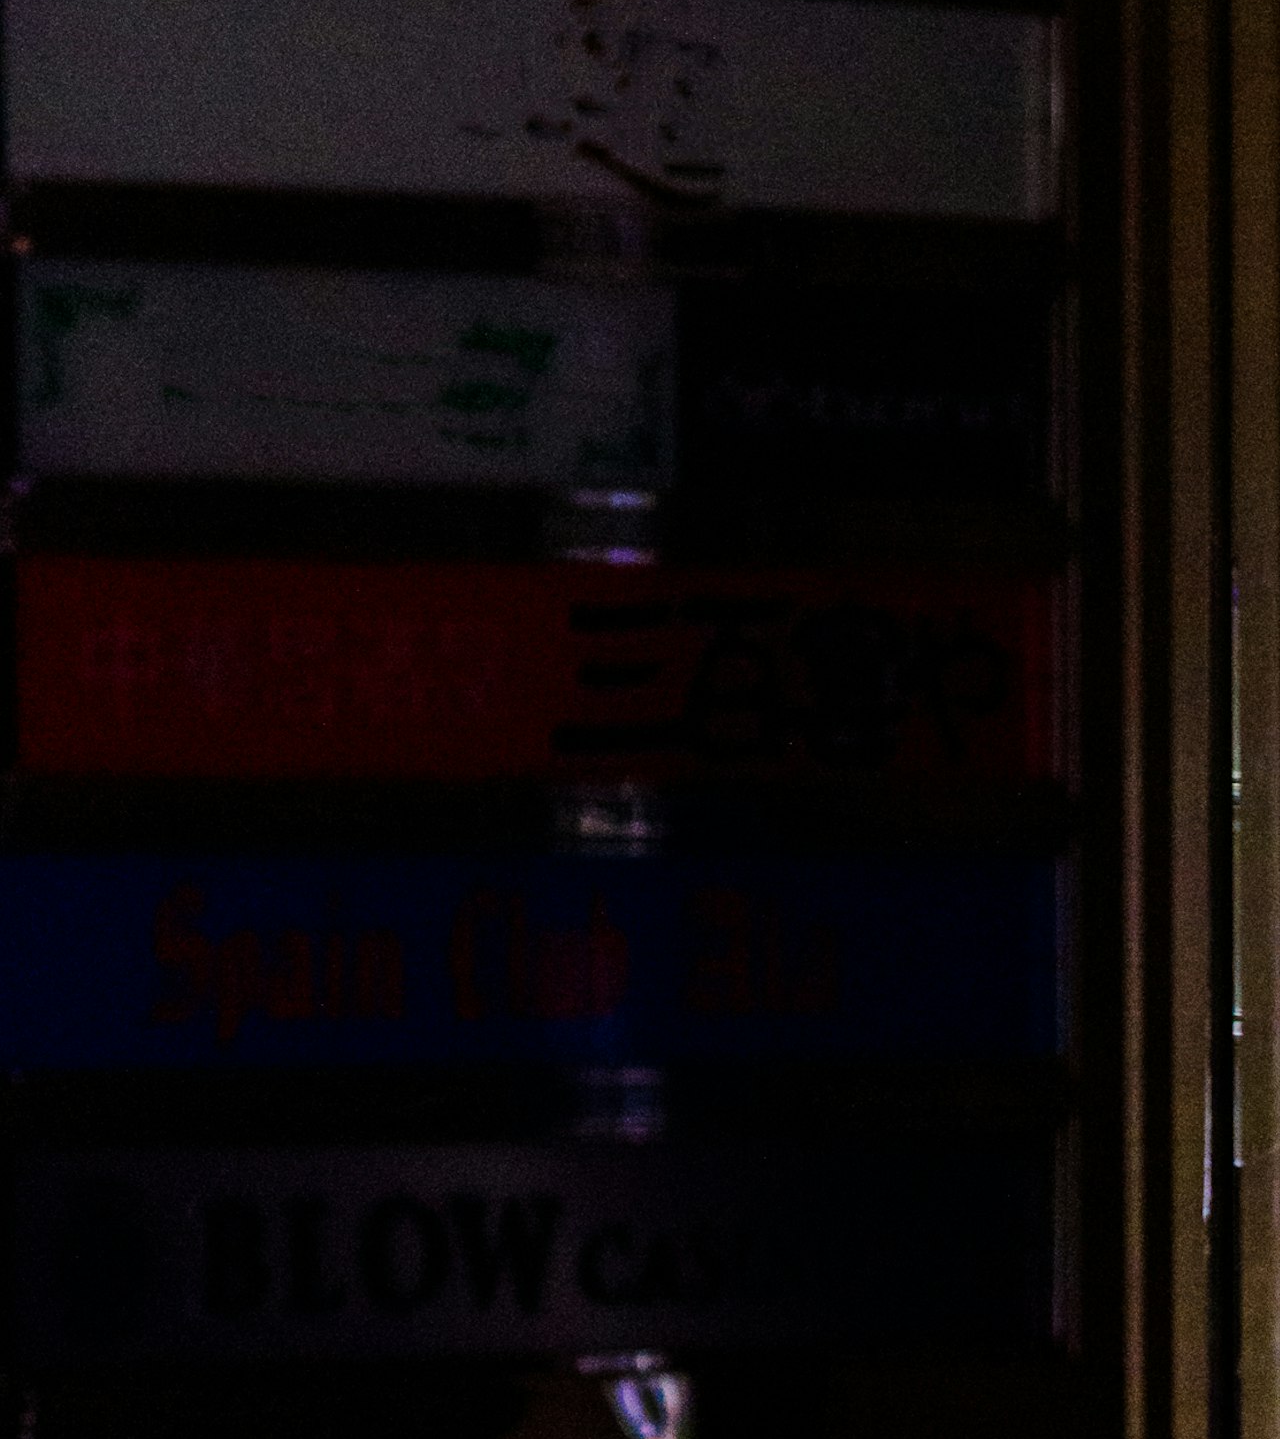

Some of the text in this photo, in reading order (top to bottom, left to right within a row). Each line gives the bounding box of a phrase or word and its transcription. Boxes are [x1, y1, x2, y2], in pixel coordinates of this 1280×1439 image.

[151, 880, 406, 1046] Spain
[450, 885, 633, 1022] Club
[202, 1191, 563, 1319] BLOW
